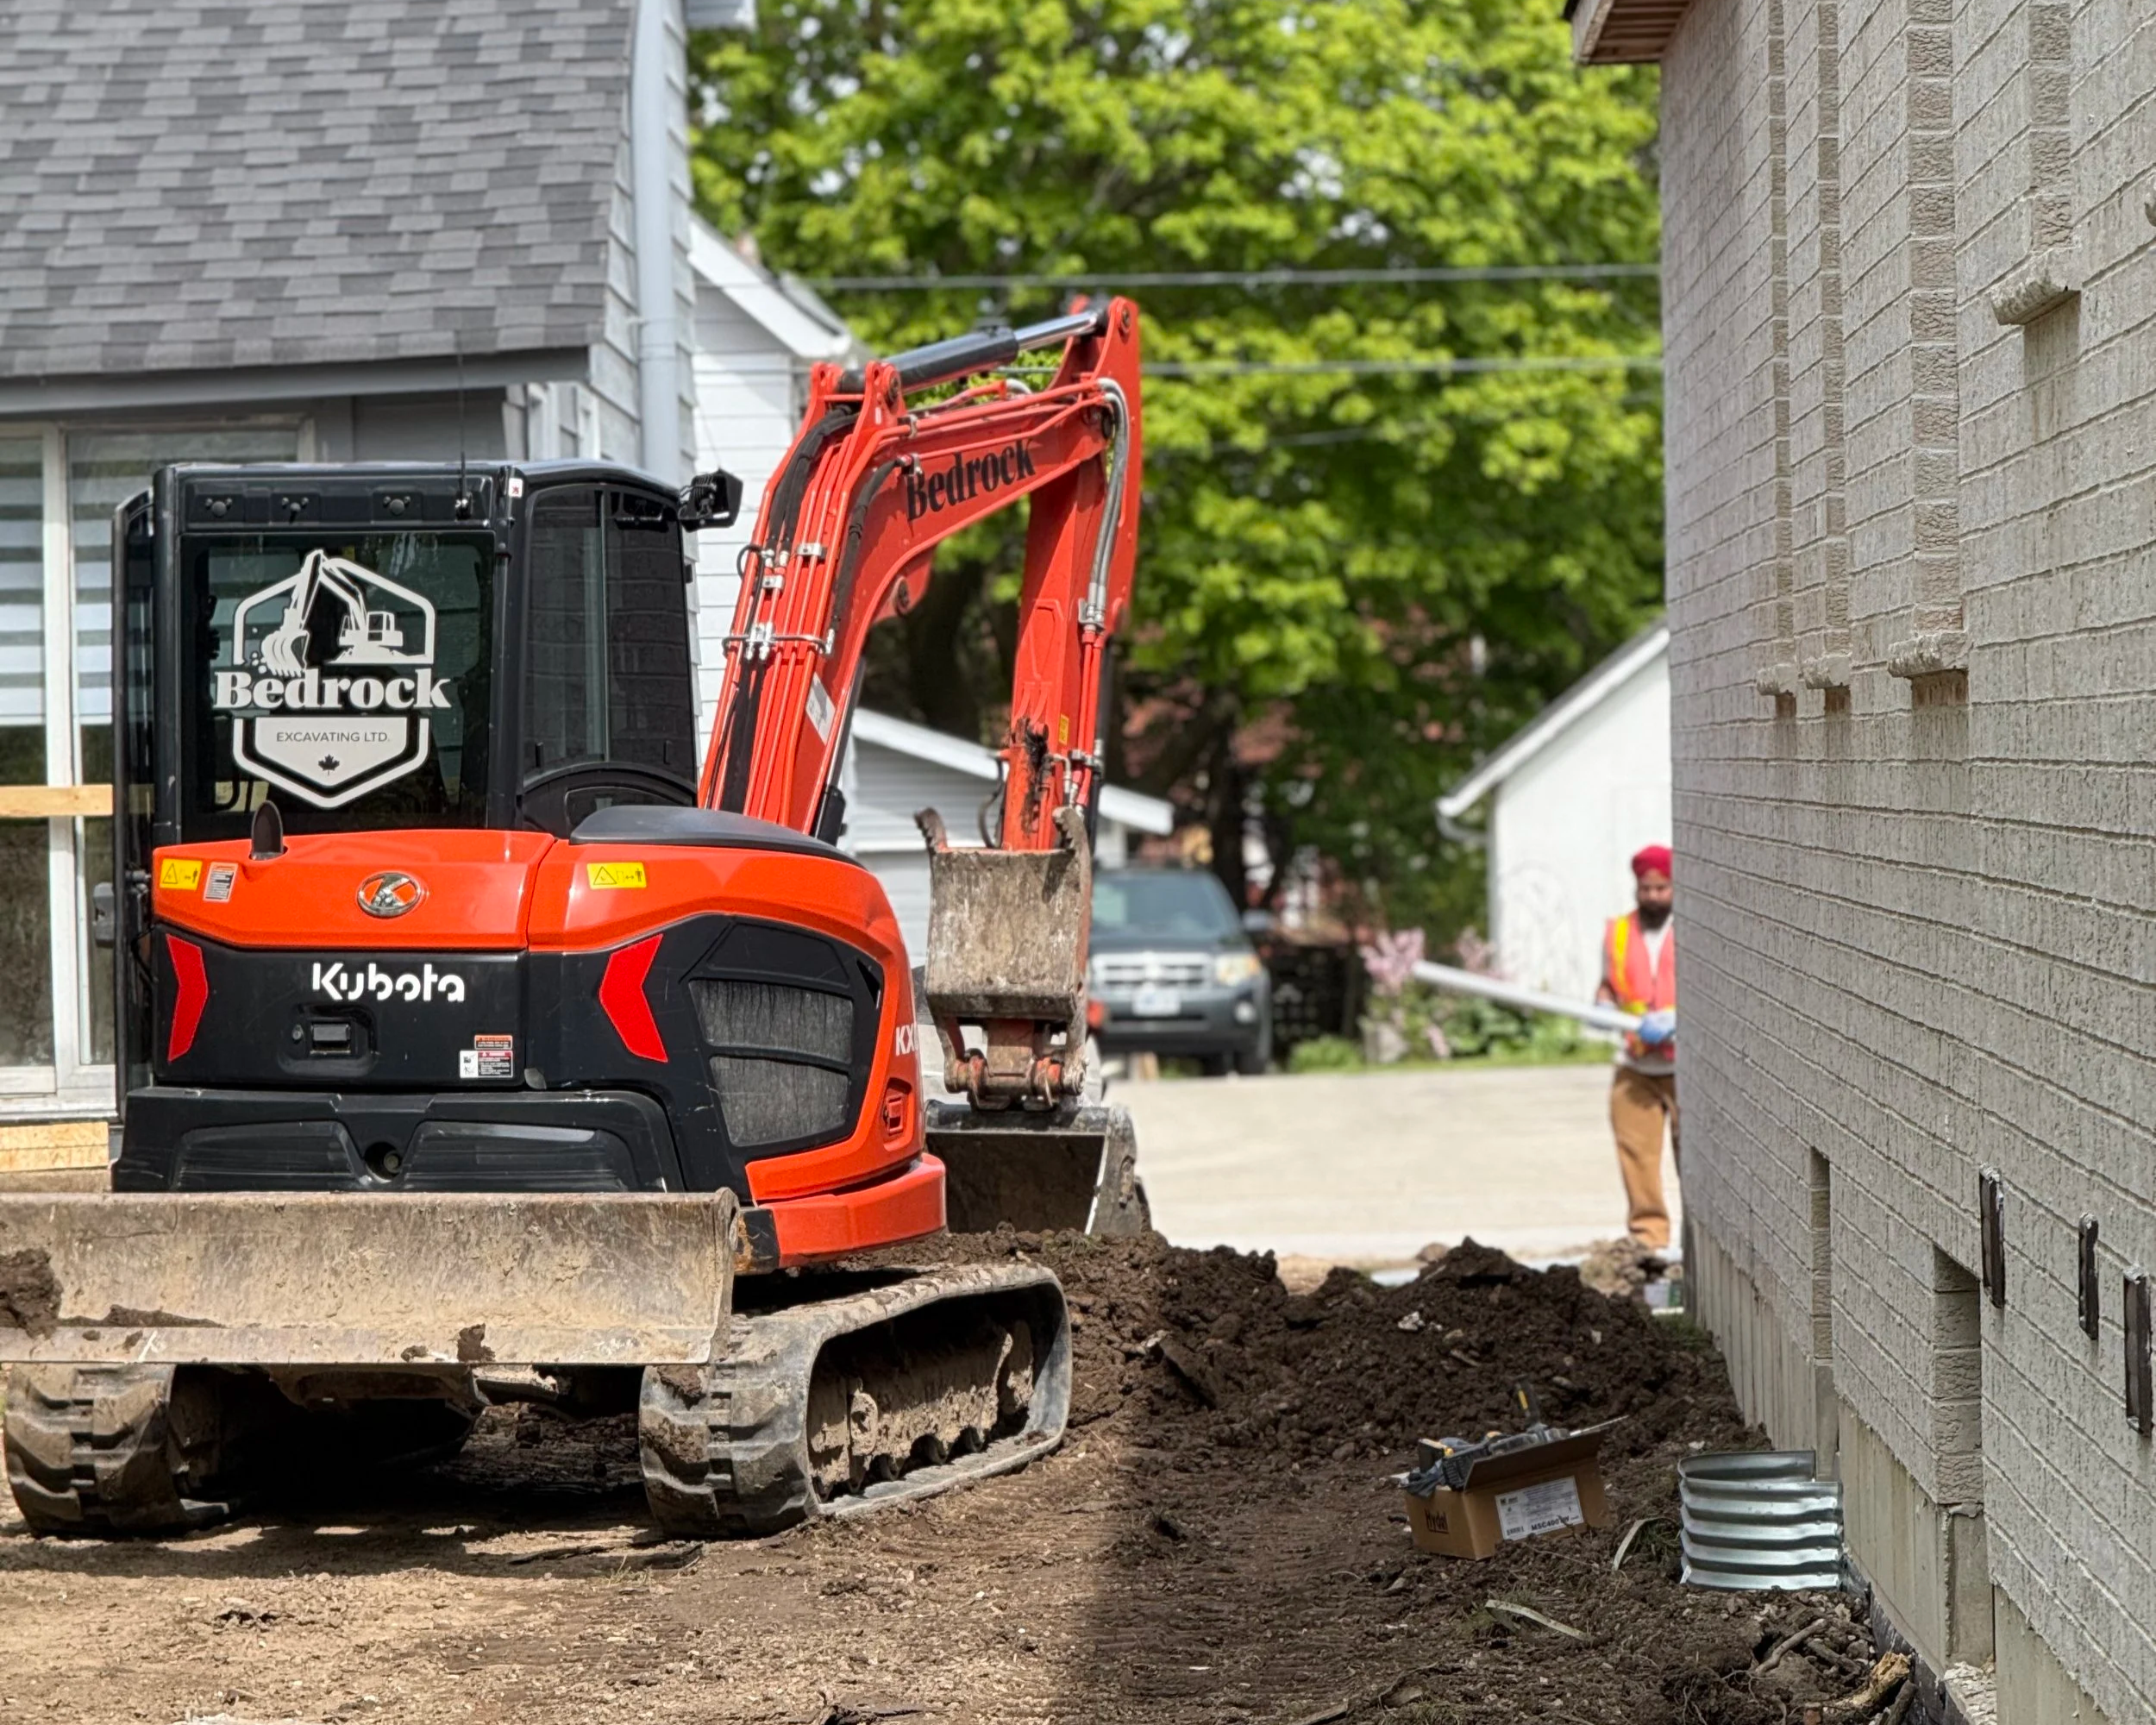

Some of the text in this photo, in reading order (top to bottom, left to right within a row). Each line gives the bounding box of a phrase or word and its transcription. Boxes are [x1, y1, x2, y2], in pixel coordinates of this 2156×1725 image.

[906, 437, 1036, 522] Bedrock
[213, 668, 452, 709] Bedrock
[276, 731, 390, 743] EXCAVATING LTD.
[312, 963, 466, 1002] Kubota
[895, 1023, 918, 1057] KX
